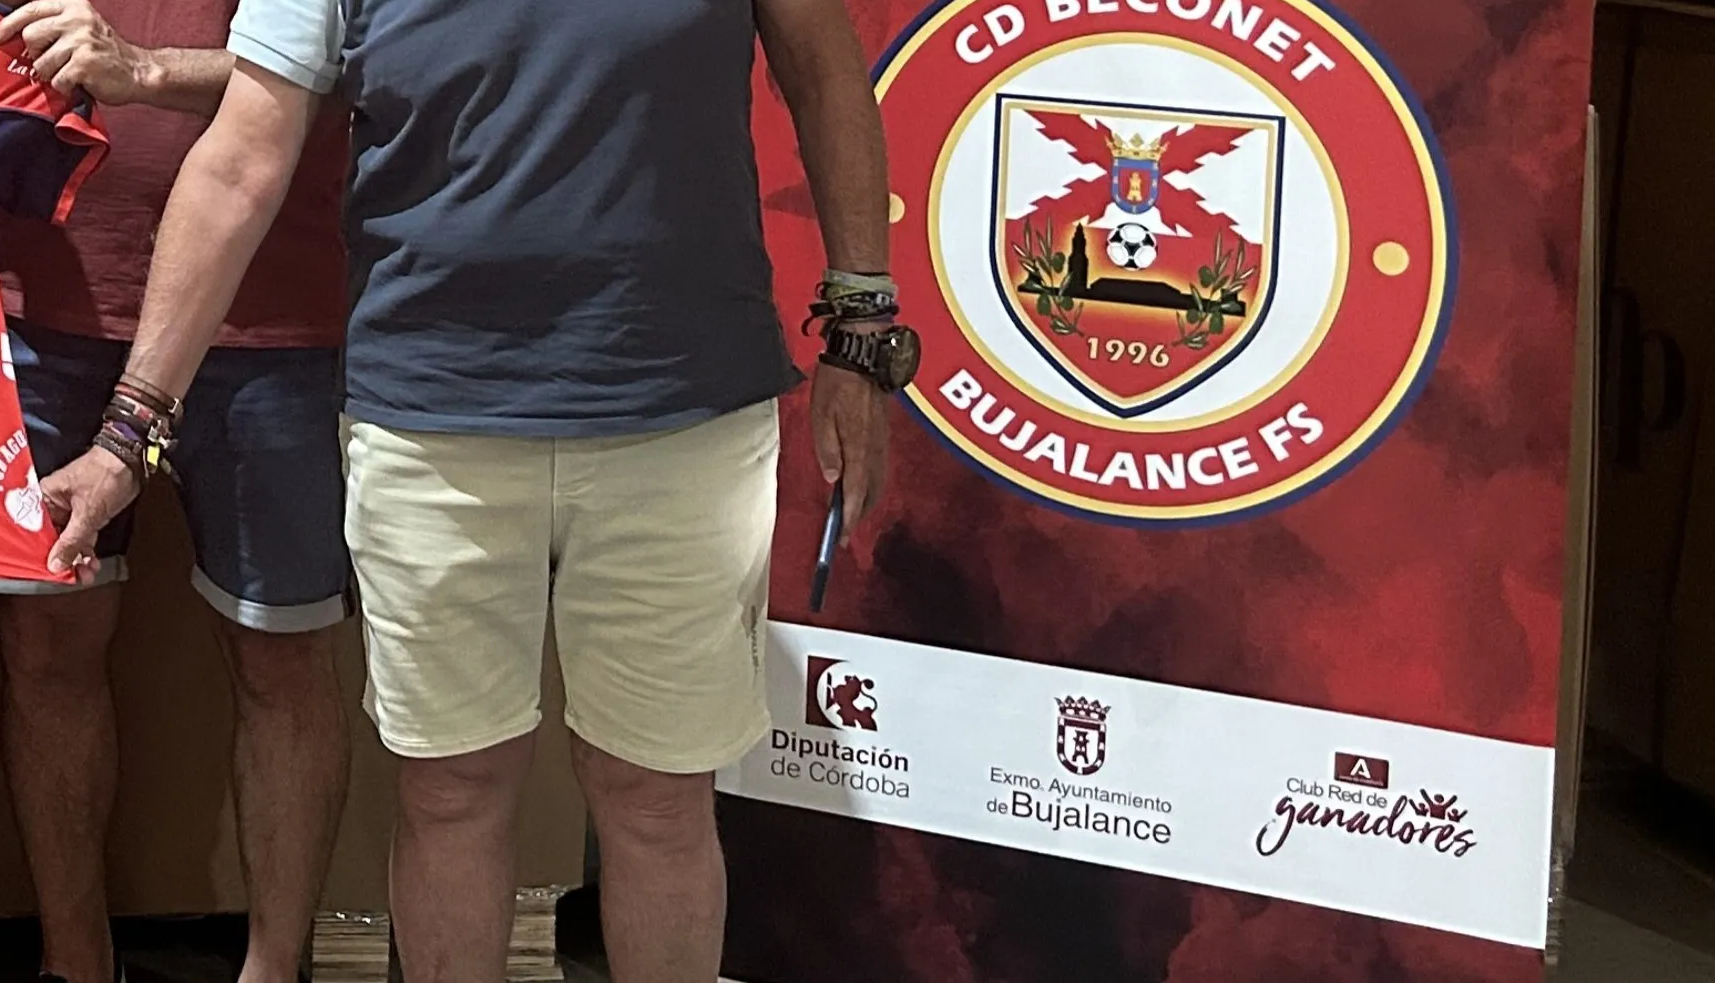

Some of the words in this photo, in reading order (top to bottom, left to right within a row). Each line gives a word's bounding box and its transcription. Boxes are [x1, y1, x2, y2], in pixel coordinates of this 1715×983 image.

[954, 4, 1027, 64] CD
[1086, 336, 1170, 369] 1996
[938, 368, 1260, 491] BUJALANCE
[1262, 402, 1325, 462] FS
[771, 728, 910, 773] Diputación
[770, 754, 802, 780] de
[808, 762, 911, 799] Córdoba
[989, 766, 1045, 791] Exmo.
[1048, 777, 1173, 815] Ayuntamiento
[1286, 777, 1324, 798] Club
[1328, 784, 1363, 805] Red
[1366, 791, 1388, 809] de
[986, 797, 1008, 816] de
[1011, 791, 1172, 845] Bujalance
[1256, 795, 1478, 858] ganadores
